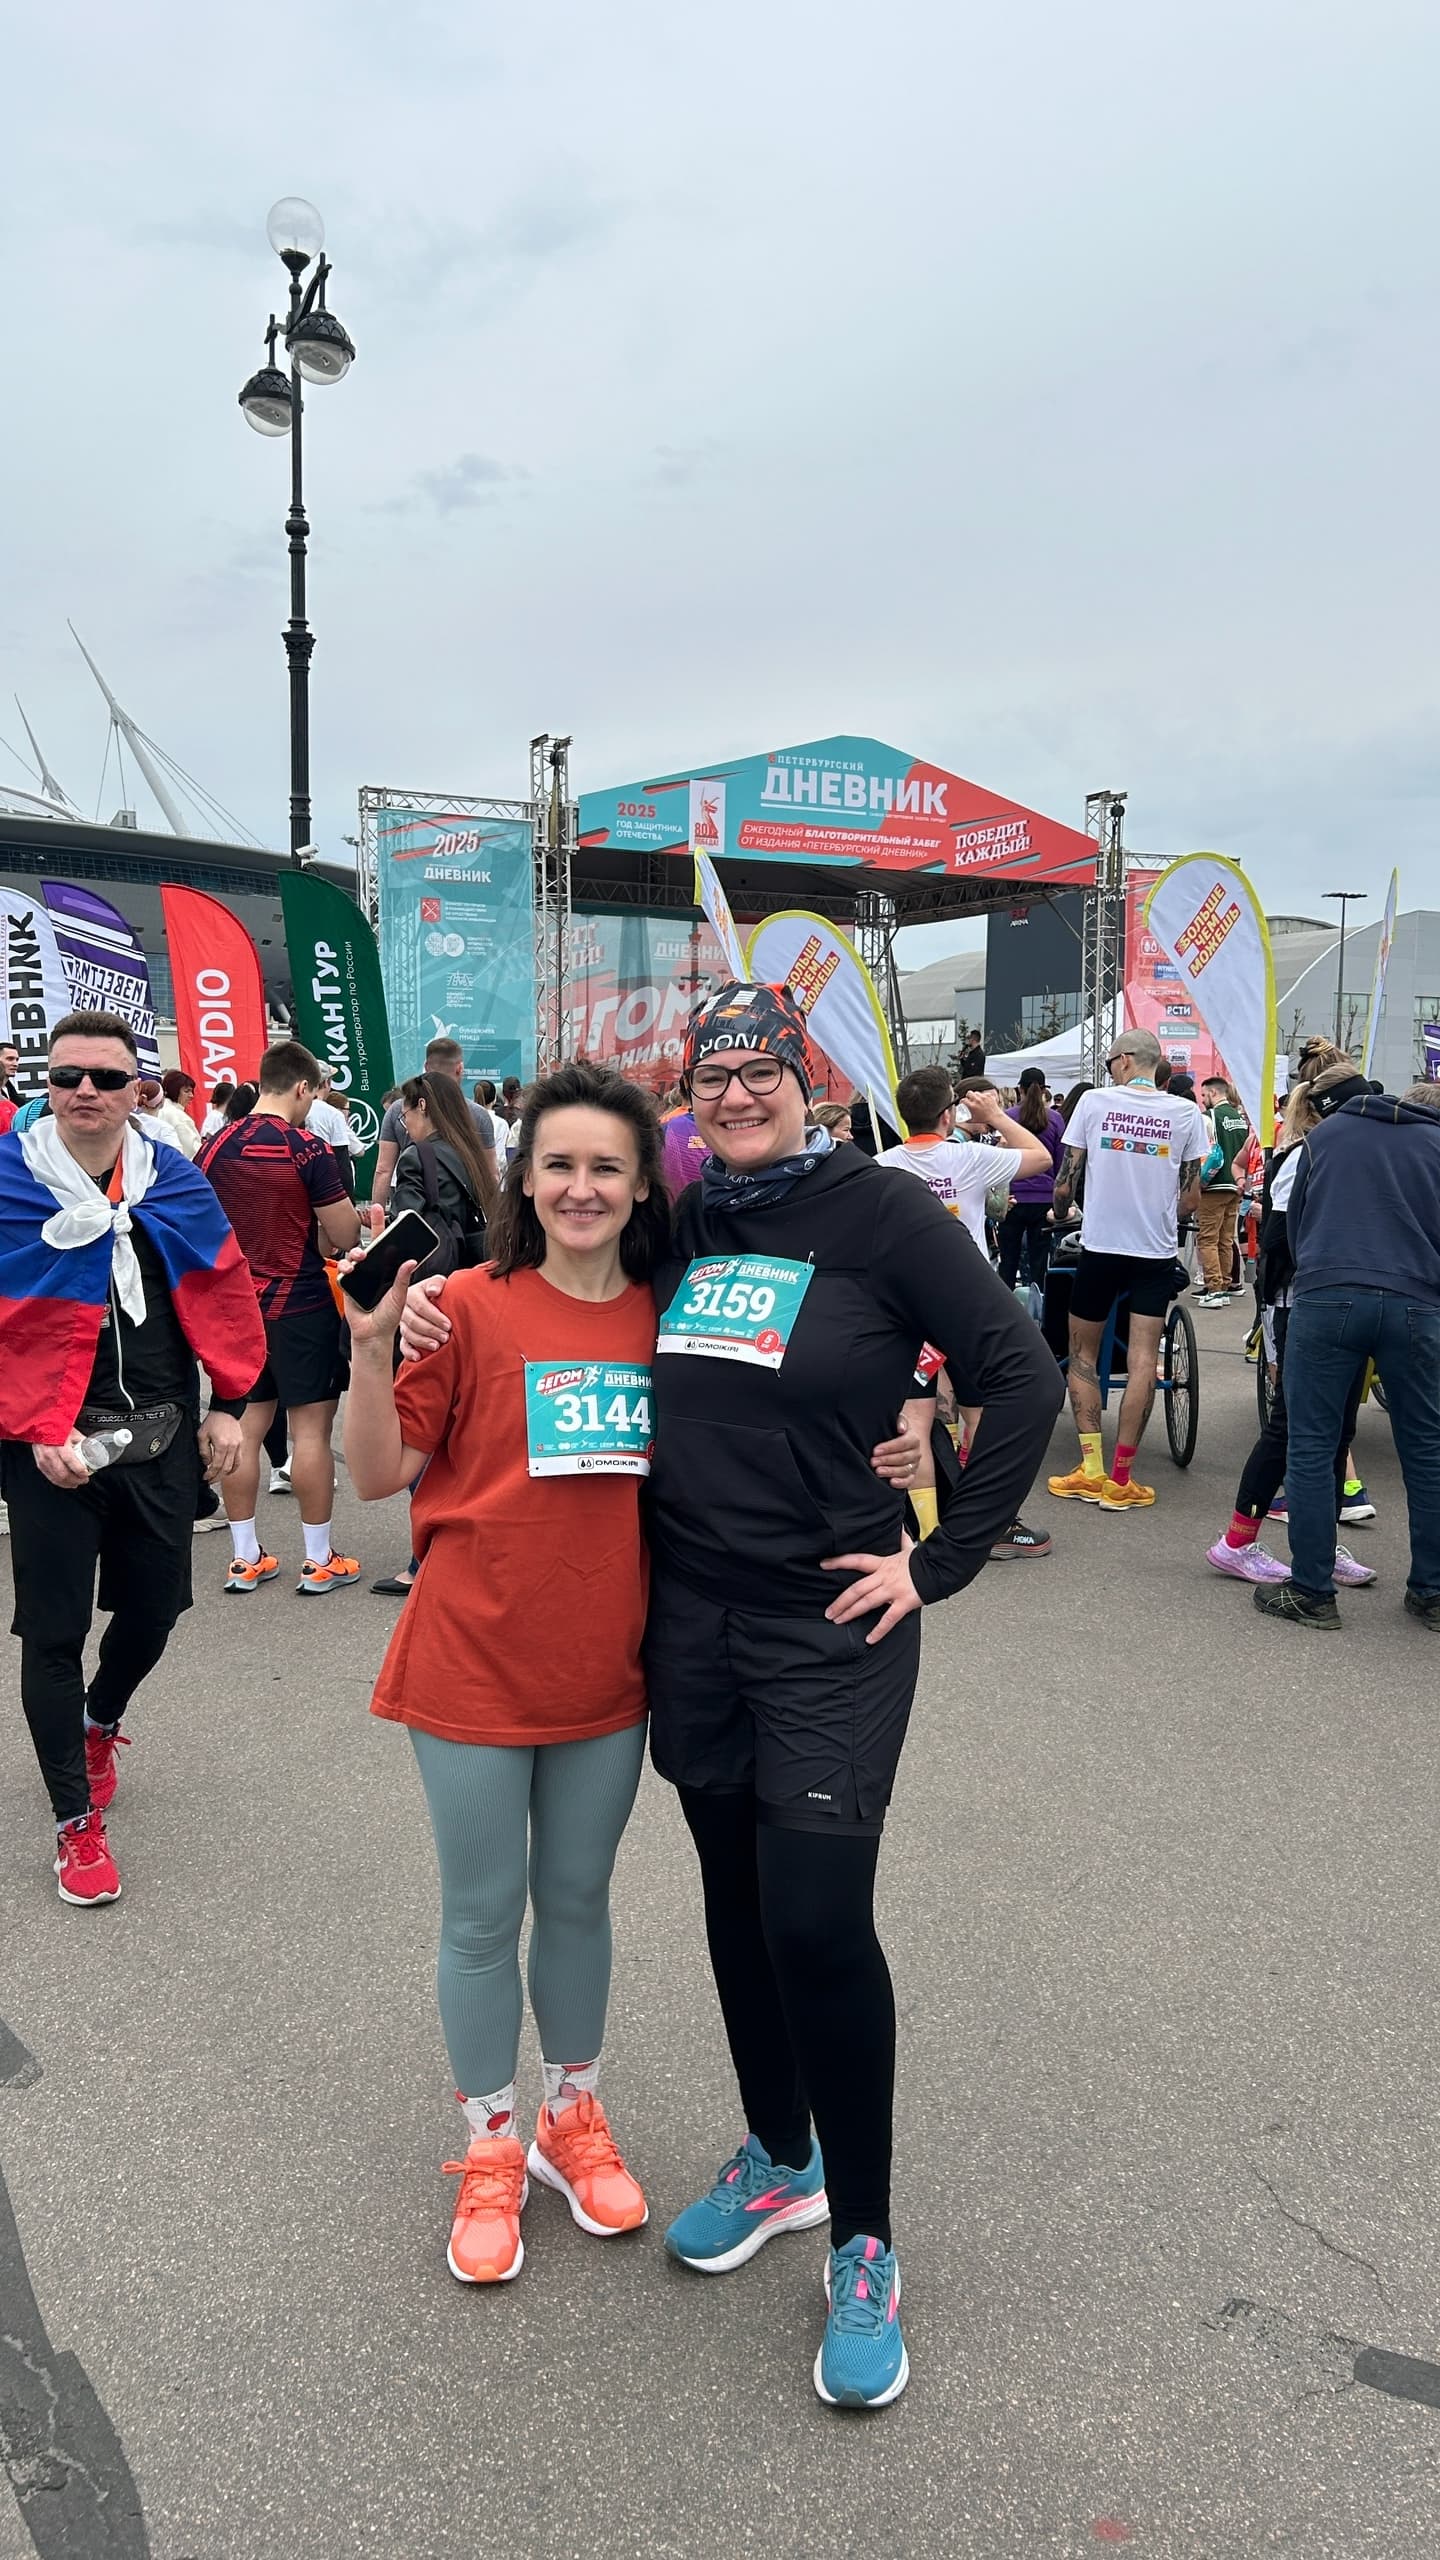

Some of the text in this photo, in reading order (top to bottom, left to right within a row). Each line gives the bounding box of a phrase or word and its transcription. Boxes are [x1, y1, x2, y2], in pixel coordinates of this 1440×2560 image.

[777, 755, 864, 771] ПЕТЕРБУРГСКИЙ
[760, 766, 948, 816] ДНЕВНИК
[616, 801, 657, 818] 2025
[616, 820, 683, 833] ГОД ЗАЩИТНИКА
[616, 830, 662, 841] ОТЕЧЕСТВА
[744, 824, 942, 849] ЕЖЕГОДНЫЙ БЛАГОТВОРИТЕЛЬНЫЙ ЗАБЕГ
[955, 820, 1028, 849] ПОБЕДИТ
[432, 829, 480, 858] 2025
[741, 837, 754, 845] ОТ
[756, 838, 801, 849] ИЗДАНИЯ
[802, 841, 881, 855] «ПЕТЕРБУРГСКИЙ
[954, 836, 1031, 867] КАЖДЫЙ!
[424, 867, 492, 883] ДНЕВНИК
[1179, 886, 1226, 951] БОЛЬШЕ
[1196, 913, 1220, 948] ЧЕМ
[1190, 906, 1241, 976] МОЖЕШЬ
[786, 936, 821, 992] БОЛЬШЕ
[801, 959, 821, 988] ЧЕМ
[801, 954, 839, 1013] МОЖЕШЬ
[8, 911, 48, 1093] НЕВНИК
[343, 941, 370, 1091] Ваш туроператор по России
[553, 982, 708, 1062] ЕГОМ
[1102, 1122, 1172, 1140] В ТАНДЕМЕ!
[1106, 1112, 1170, 1129] ДВИГАЙСЯ
[737, 1264, 800, 1283] ДНЕВНИК
[683, 1281, 776, 1322] 3159
[919, 1350, 933, 1366] 7
[536, 1369, 583, 1391] БЕГОМ
[604, 1373, 652, 1388] ДНЕВНИ
[554, 1393, 651, 1434] 3144
[1013, 1535, 1035, 1545] HOKA
